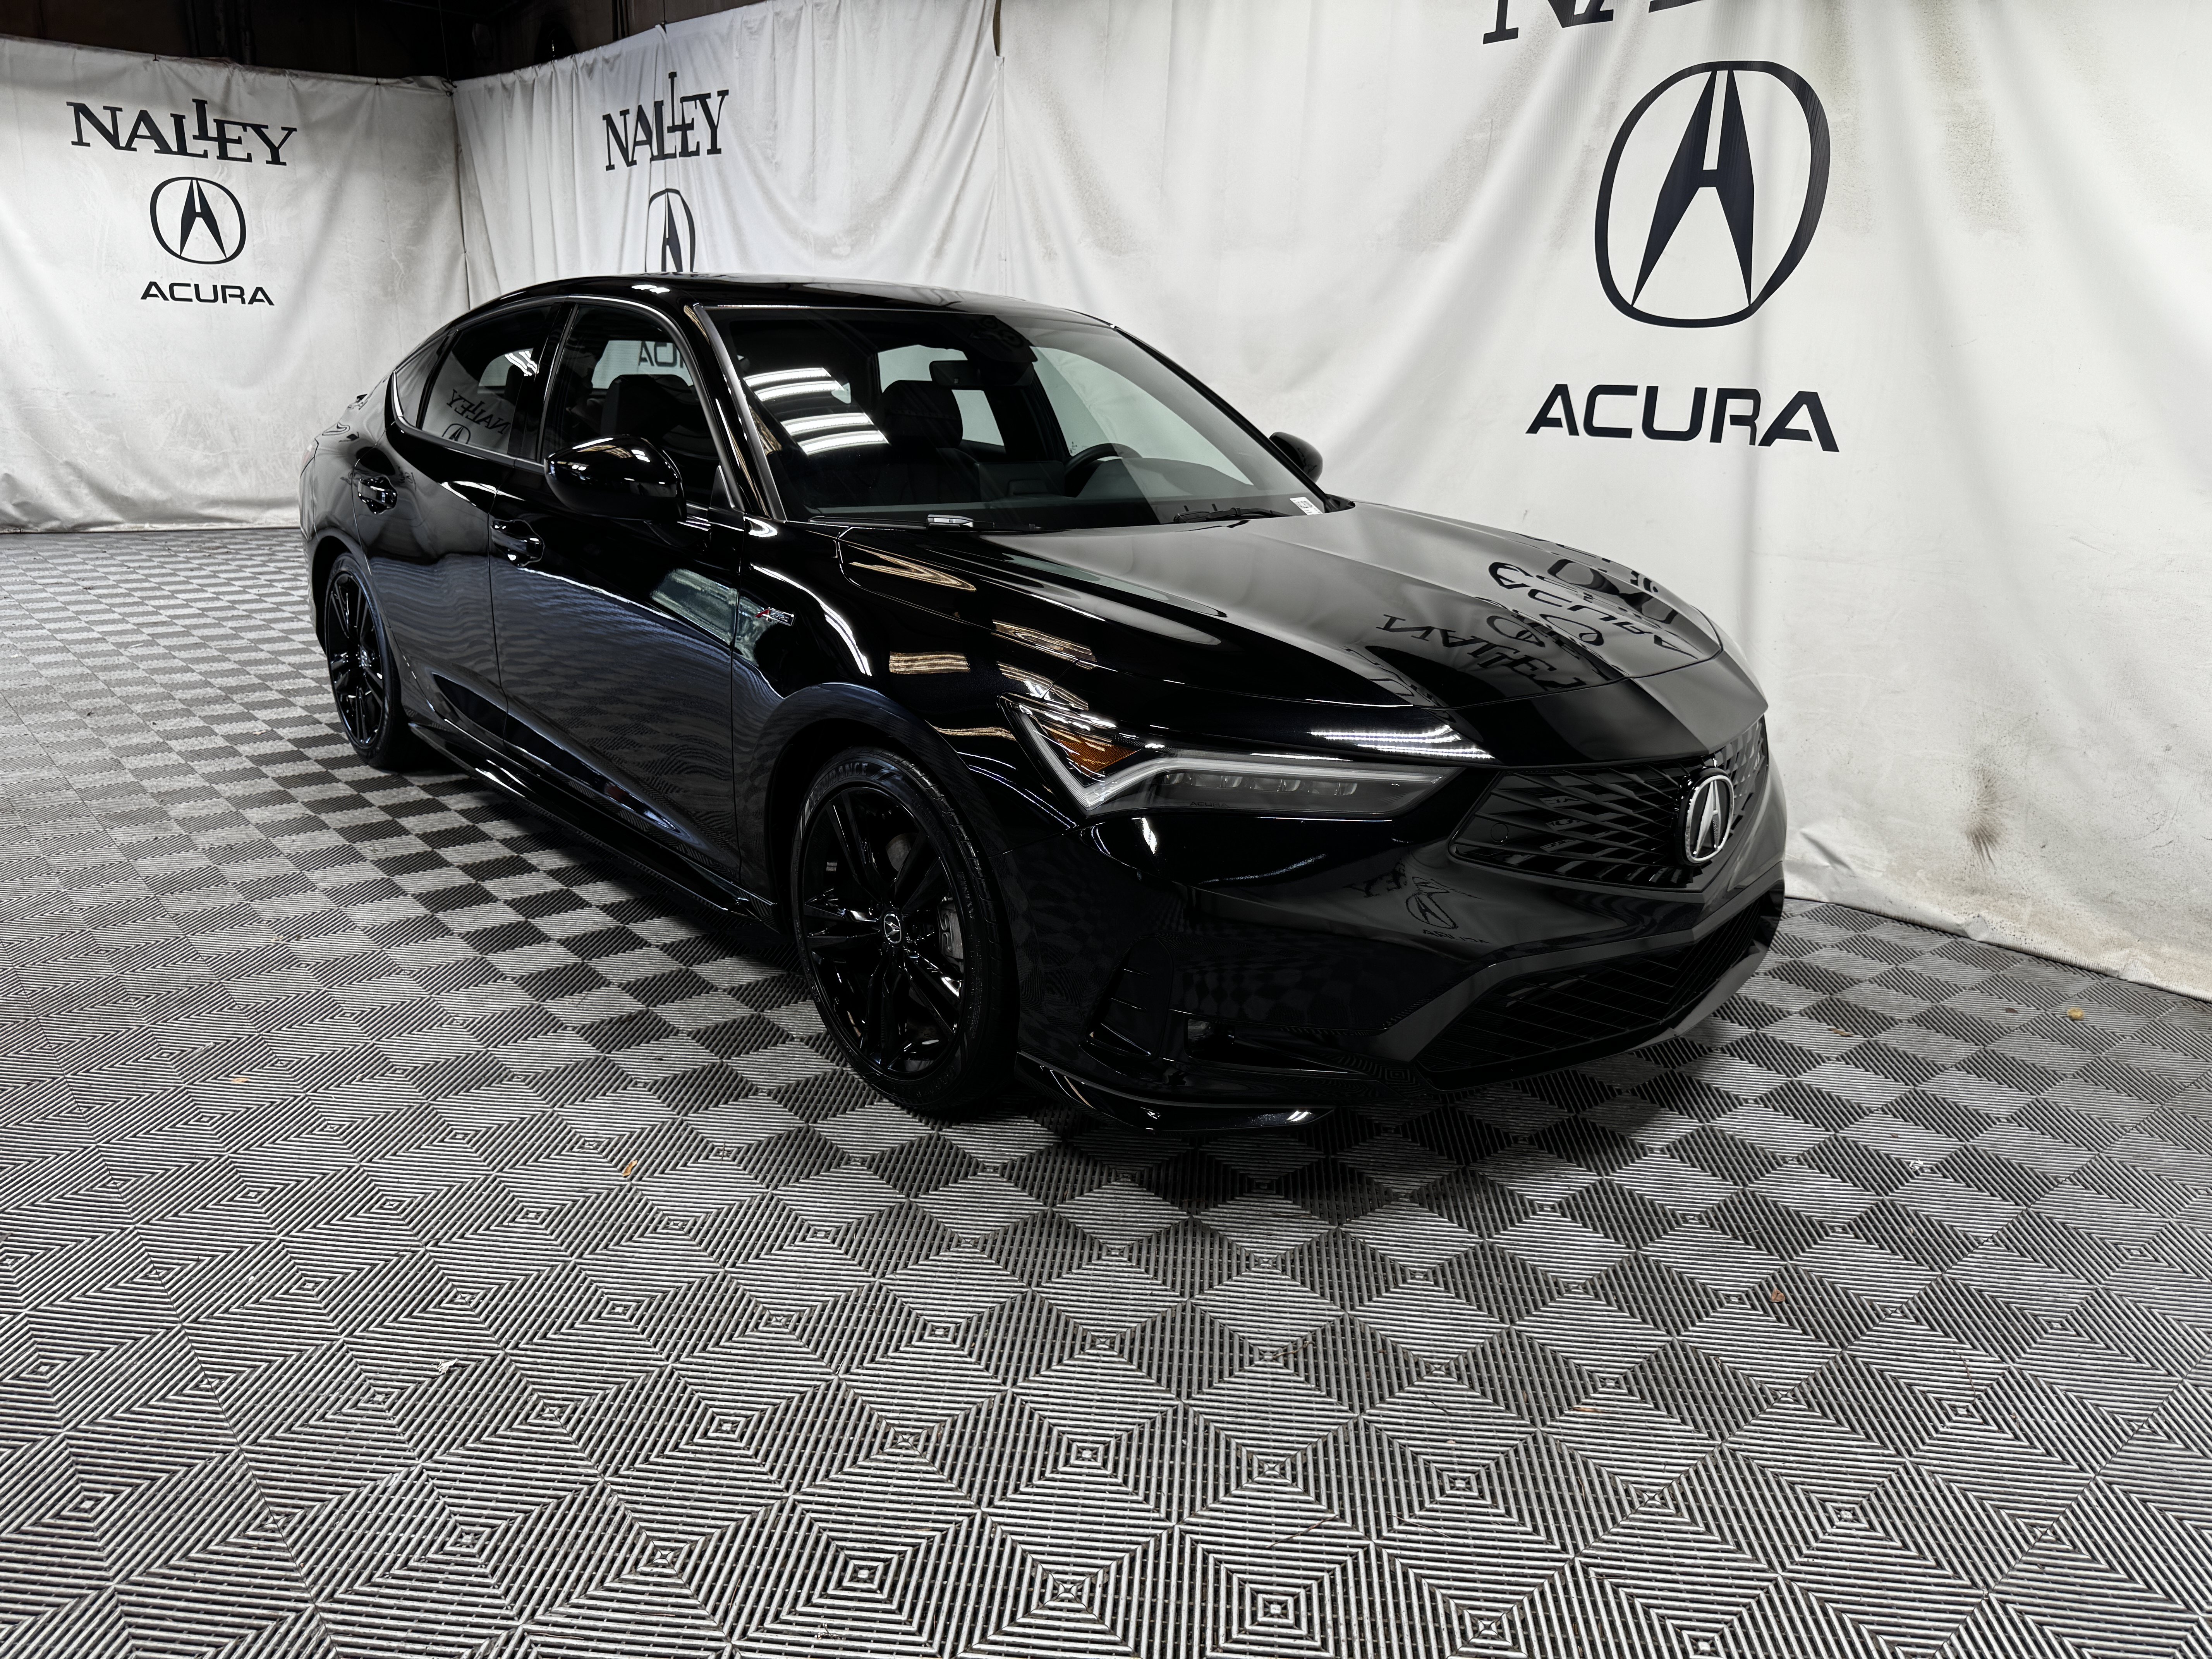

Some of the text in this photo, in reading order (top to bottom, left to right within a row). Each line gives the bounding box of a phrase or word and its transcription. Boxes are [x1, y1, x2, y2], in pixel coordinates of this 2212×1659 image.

[66, 98, 297, 167] NALLEY
[602, 71, 729, 172] NALLEY
[140, 281, 275, 306] ACURA
[1525, 383, 1840, 453] ACURA
